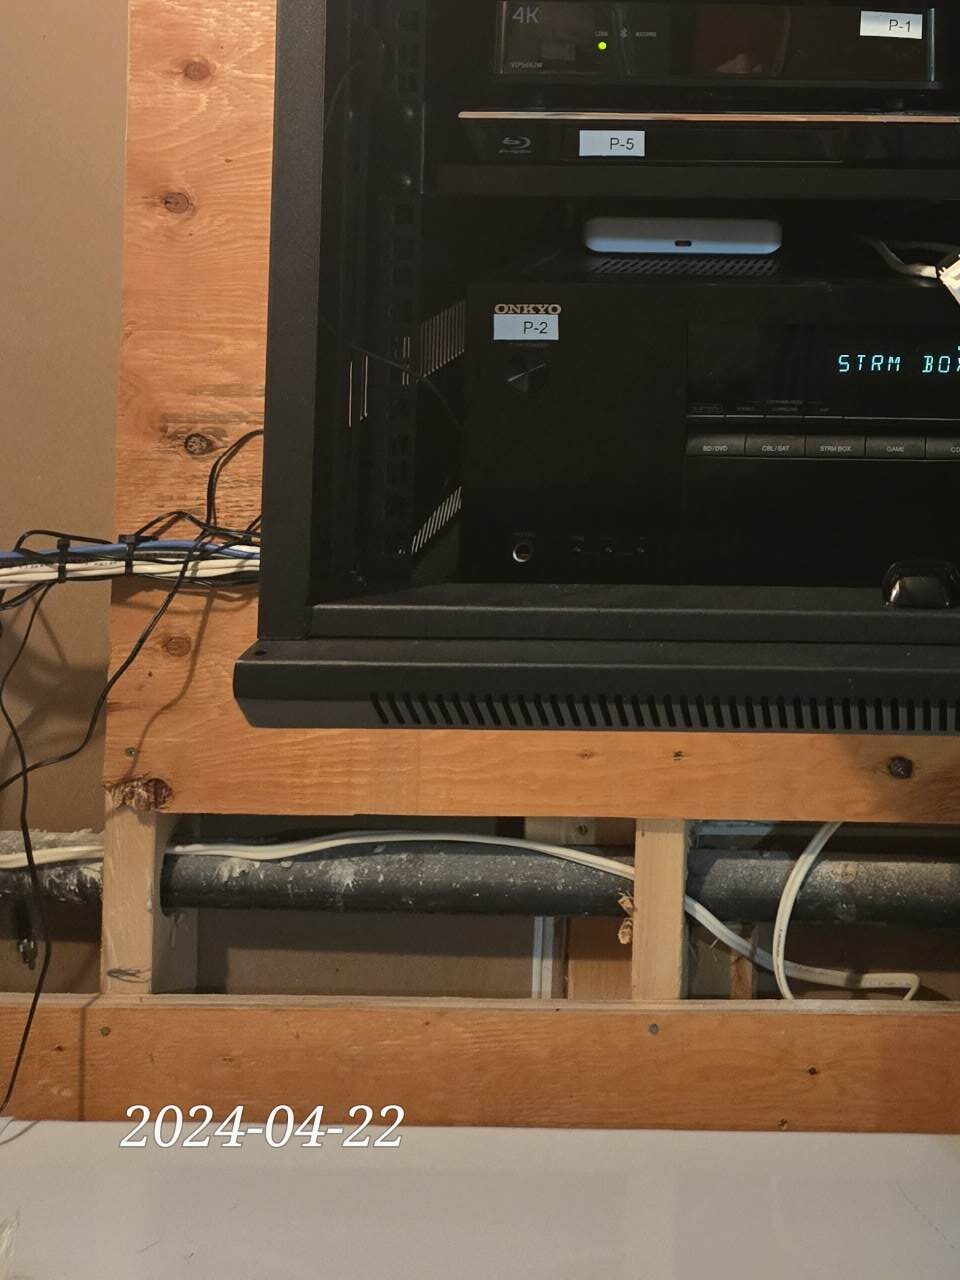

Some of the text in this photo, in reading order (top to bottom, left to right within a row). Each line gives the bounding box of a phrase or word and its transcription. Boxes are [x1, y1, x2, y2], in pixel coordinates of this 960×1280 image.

[511, 6, 540, 24] 4K
[888, 18, 913, 33] P-1
[609, 136, 635, 151] P-5
[494, 303, 562, 315] ONKYO
[523, 321, 548, 334] P-2
[838, 354, 901, 372] STRM
